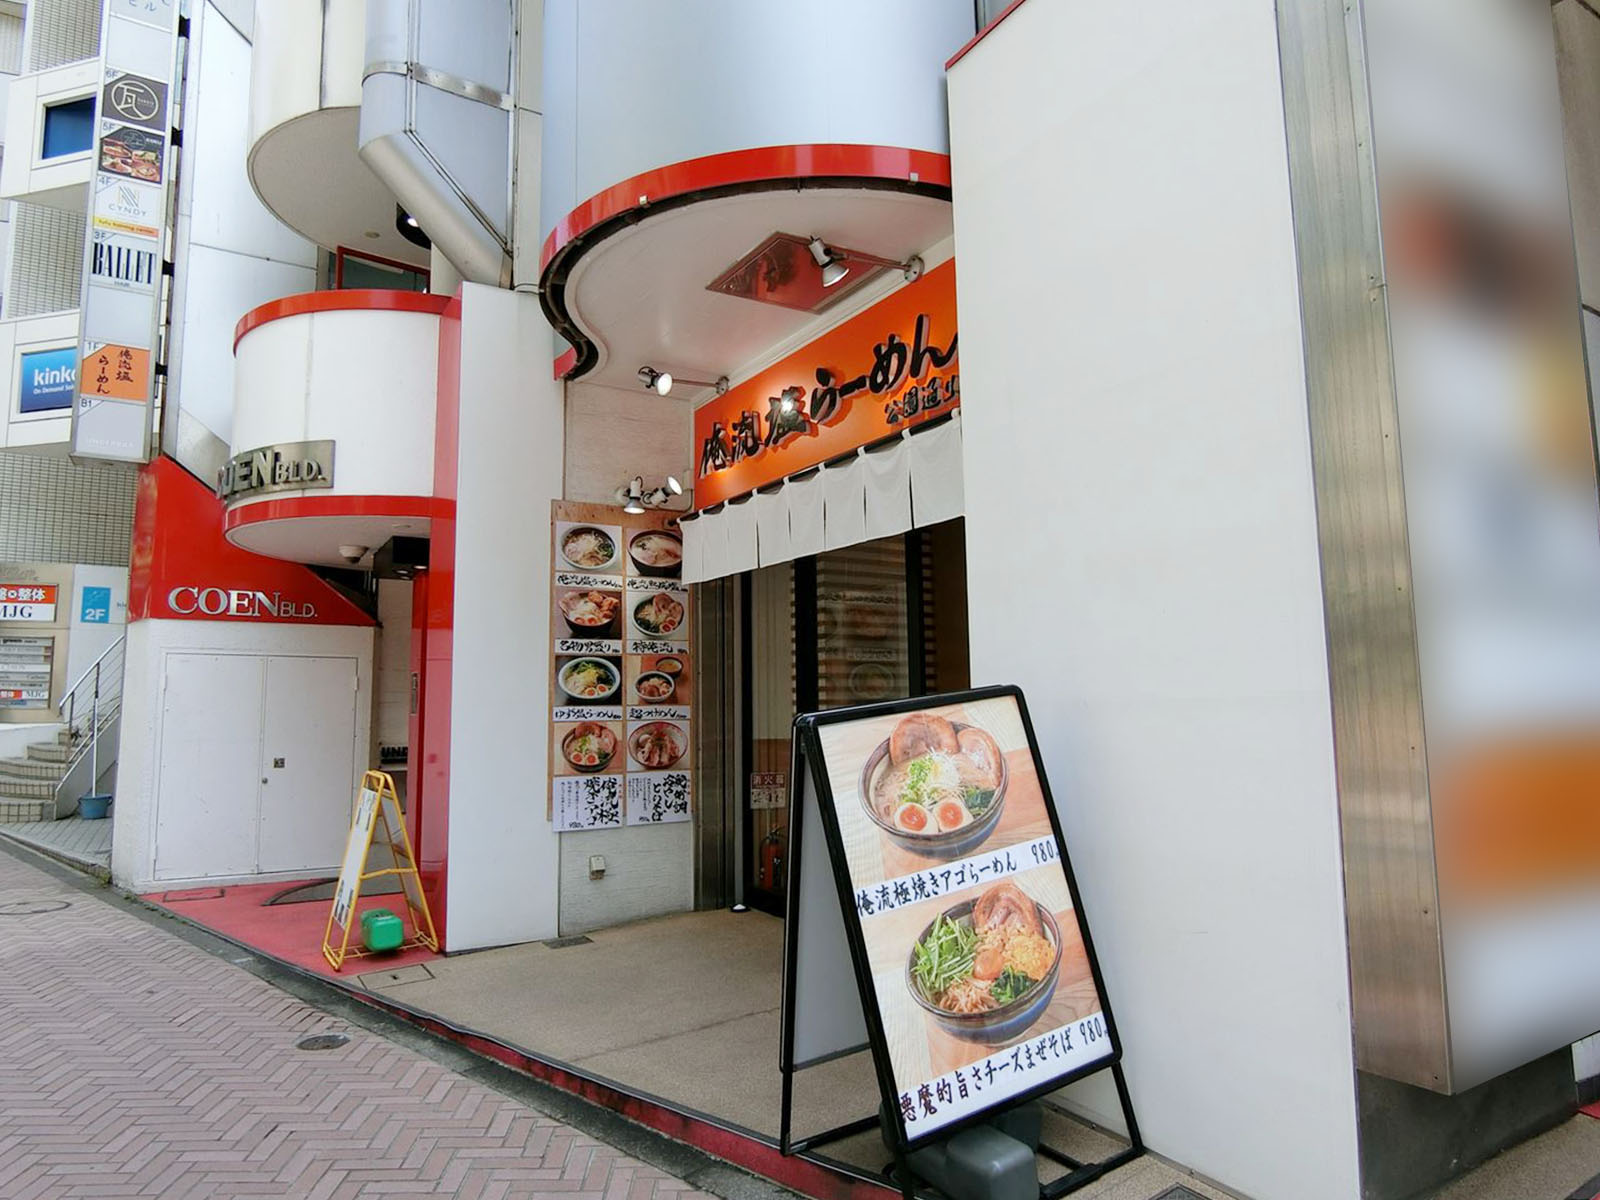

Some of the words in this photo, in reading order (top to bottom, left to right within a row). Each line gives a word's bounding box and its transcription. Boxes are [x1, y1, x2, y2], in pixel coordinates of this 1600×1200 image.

[102, 122, 115, 132] 5F
[94, 231, 106, 240] 3F
[96, 354, 111, 394] らーめん
[85, 608, 105, 620] 2F
[167, 586, 281, 617] COEN
[280, 601, 318, 618] BLD.
[856, 851, 1017, 917] 俺流極焼きアゴらーめん
[900, 1027, 1074, 1123] 悪魔的旨さチーズまぜそば
